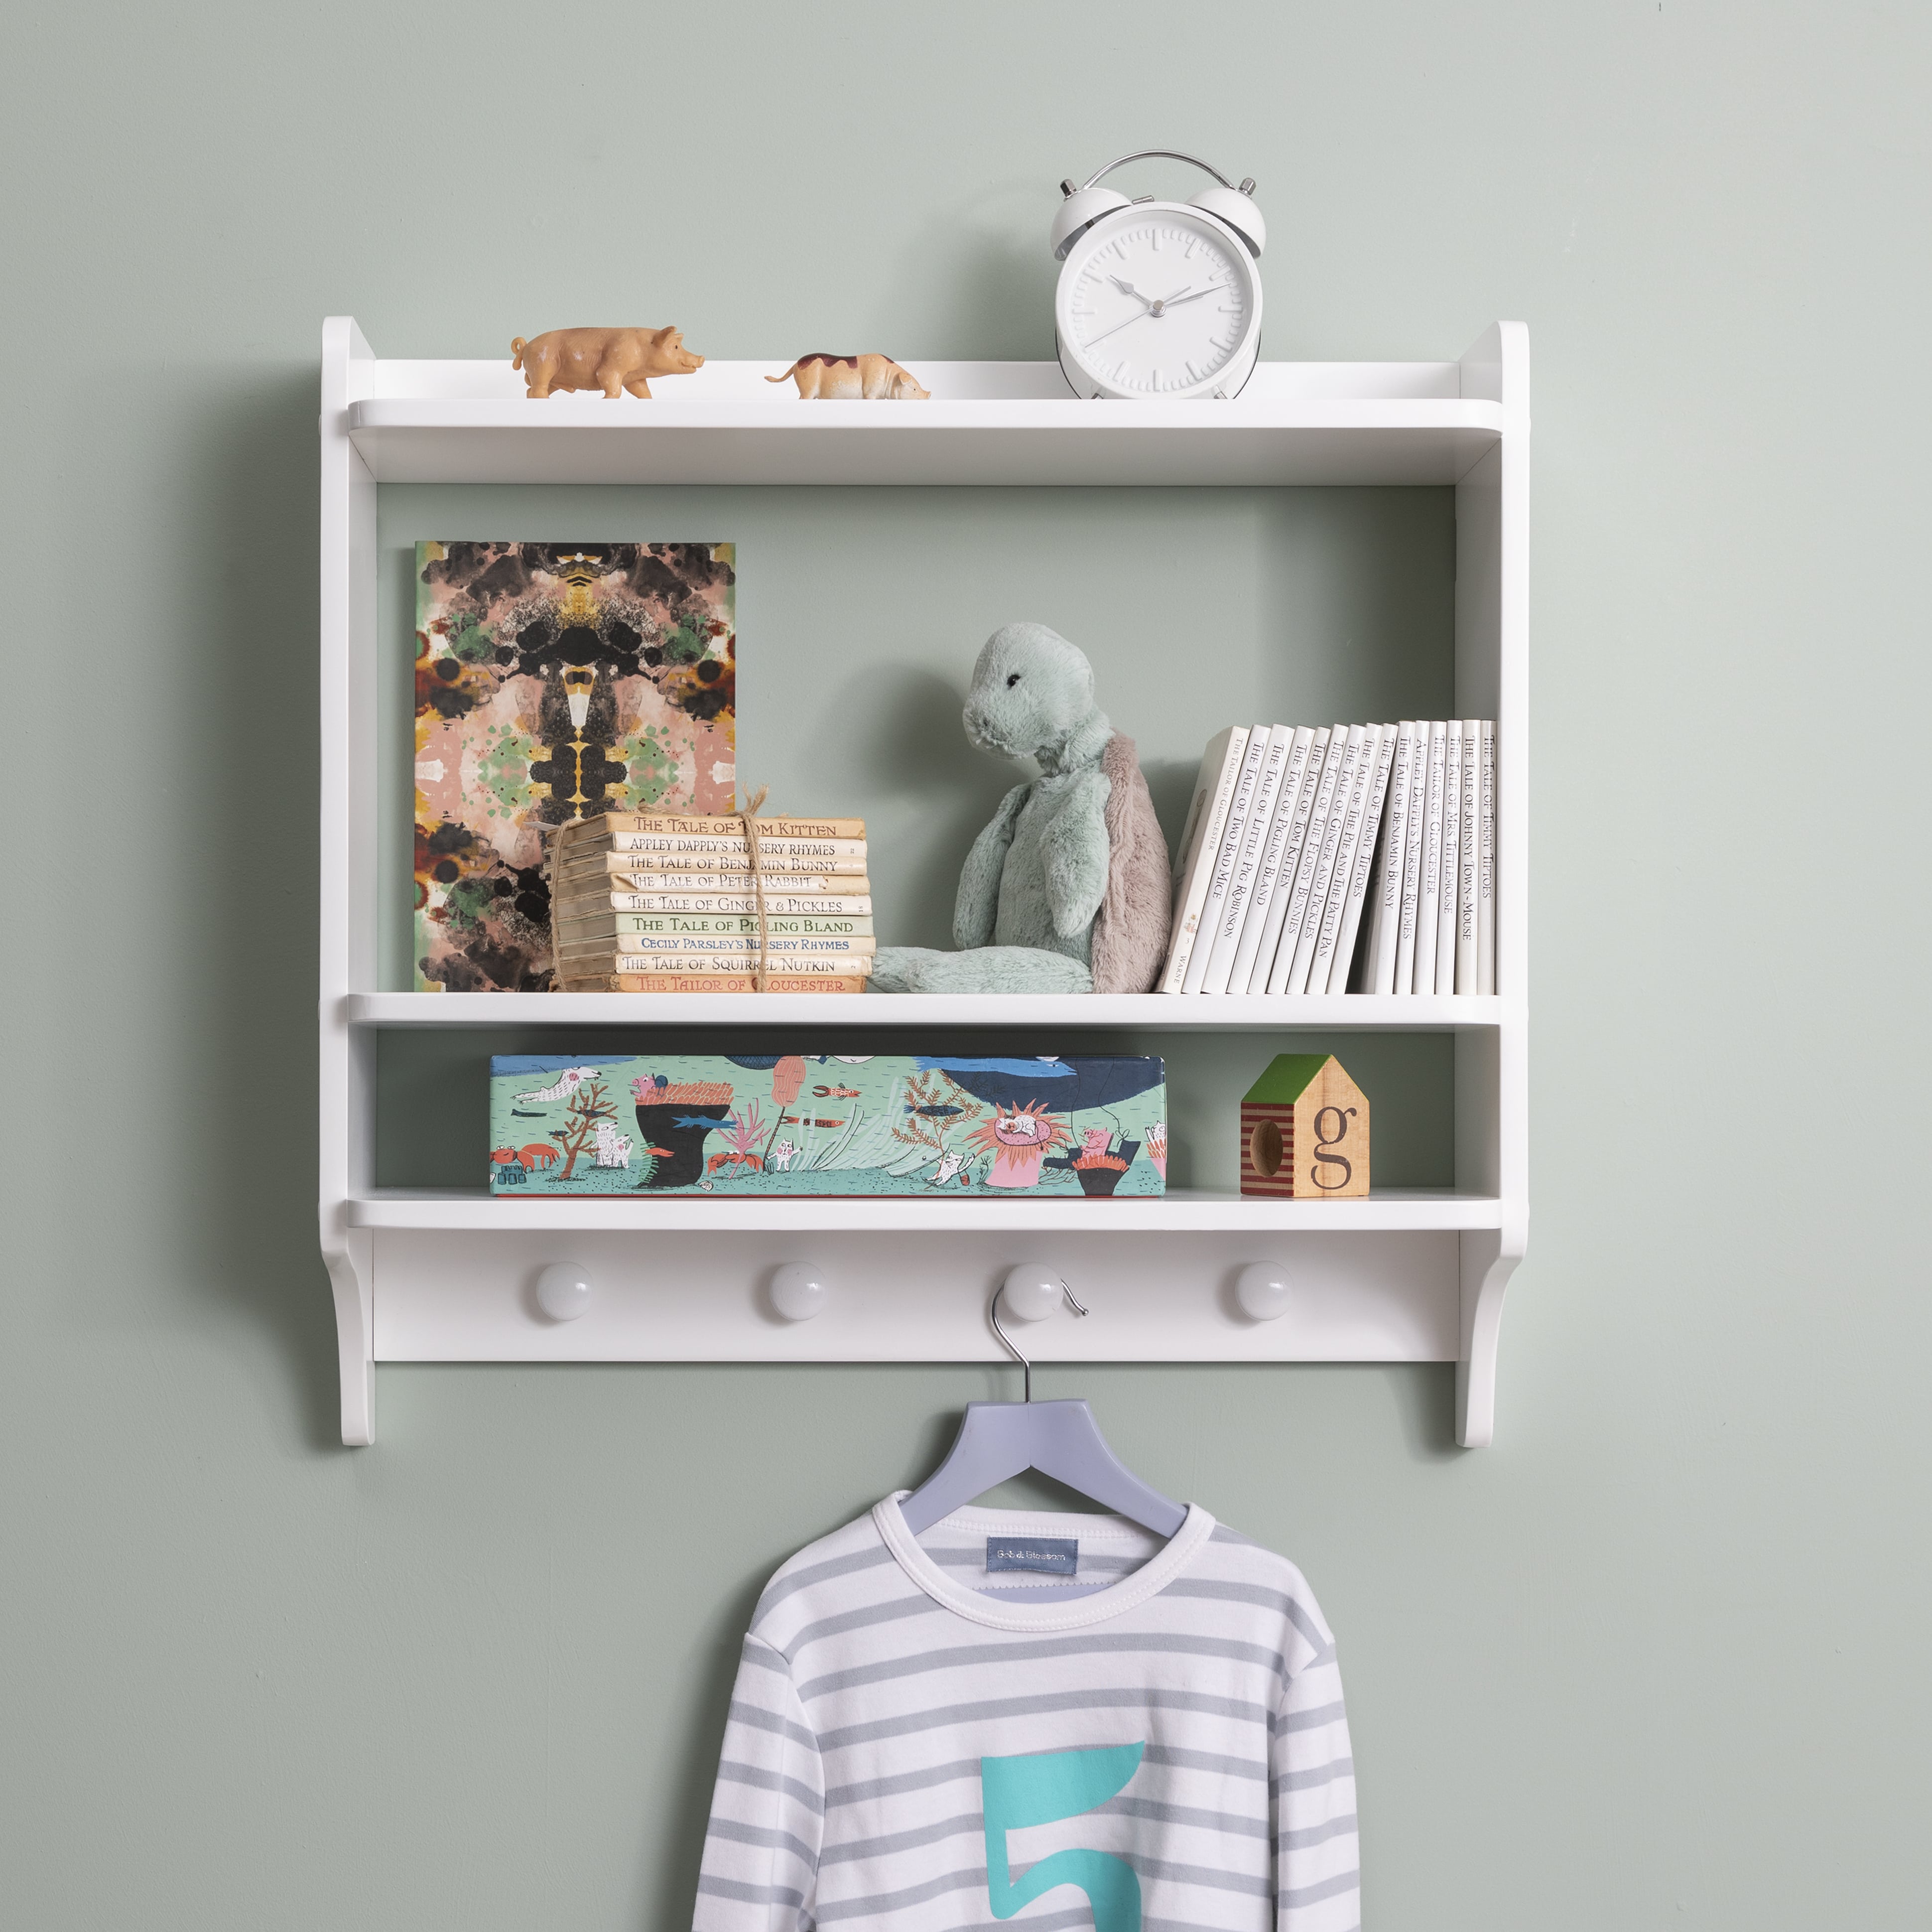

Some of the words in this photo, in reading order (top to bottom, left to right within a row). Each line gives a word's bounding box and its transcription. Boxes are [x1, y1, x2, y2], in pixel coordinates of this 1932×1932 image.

[1233, 738, 1243, 755] THE
[1250, 742, 1264, 764] THE
[1270, 744, 1284, 765] THE
[1293, 744, 1307, 766] THE
[1311, 743, 1326, 765] THE
[1330, 741, 1344, 762] THE
[1345, 743, 1360, 765] THE
[1362, 738, 1375, 759] THE
[1381, 738, 1395, 760] THE
[1399, 736, 1411, 758] THE
[1434, 735, 1445, 756] THE
[1450, 735, 1460, 757] THE
[1465, 735, 1476, 758] THE
[1484, 735, 1495, 757] THE
[1225, 757, 1238, 785] TAILOR
[1415, 739, 1426, 783] APPLEY
[1241, 767, 1257, 795] TALE
[1261, 769, 1278, 797] TALE
[1285, 770, 1301, 797] TALE
[1303, 769, 1320, 797] TALE
[1322, 766, 1337, 794] TALE
[1338, 769, 1353, 797] TALE
[1355, 763, 1369, 789] TALE
[1374, 764, 1389, 792] TALE
[1396, 761, 1408, 790] TALE
[1432, 759, 1443, 800] TAILOR
[1448, 761, 1459, 789] TALE
[1465, 762, 1475, 790] TALE
[1484, 762, 1494, 791] TALE
[1222, 787, 1232, 798] OF
[1352, 792, 1361, 806] OF
[1371, 796, 1381, 811] OF
[1395, 793, 1403, 808] OF
[1448, 794, 1456, 808] OF
[1465, 794, 1473, 809] OF
[1484, 795, 1492, 809] OF
[1236, 798, 1246, 816] OF
[1257, 800, 1267, 815] OF
[1281, 800, 1290, 816] OF
[1299, 800, 1309, 816] OF
[1318, 797, 1328, 812] OF
[1334, 800, 1343, 816] OF
[1431, 803, 1439, 817] OF
[634, 817, 662, 831] THE
[667, 819, 708, 832] TALE
[714, 823, 736, 833] OF
[778, 823, 836, 835] KITTEN
[1208, 800, 1227, 850] GLOUCESTER
[1229, 817, 1244, 839] TWO
[1311, 817, 1326, 838] THE
[1347, 809, 1360, 829] THE
[1245, 819, 1264, 858] LITTLE
[1267, 819, 1288, 863] PIGLING
[1292, 820, 1306, 842] TOM
[1322, 818, 1341, 860] GINGER
[1342, 832, 1355, 849] PIE
[1363, 814, 1379, 850] TIMMY
[1389, 811, 1404, 866] BENJAMIN
[1464, 811, 1474, 858] JOHNNY
[1483, 813, 1494, 849] TIMMY
[630, 838, 673, 850] APPLEY
[677, 840, 728, 851] DAPPLY'S
[732, 841, 785, 853] NUSERY
[789, 844, 835, 855] RHYMES
[1221, 843, 1236, 867] BAD
[1427, 822, 1440, 894] GLOUCESTER
[628, 854, 654, 868] THE
[658, 855, 691, 868] TALE
[697, 859, 714, 869] OF
[791, 858, 838, 871] BUNNY
[1239, 861, 1253, 881] PIG
[1280, 846, 1299, 889] KITTEN
[1301, 842, 1319, 883] FLOPSY
[1336, 852, 1347, 876] AND
[1407, 840, 1419, 890] NURSERY
[630, 874, 654, 886] THE
[660, 874, 692, 886] TALE
[698, 876, 714, 886] OF
[719, 873, 757, 886] PETER
[765, 874, 812, 887] RABBIT
[1213, 869, 1229, 899] MICE
[1257, 866, 1276, 905] BLAND
[1316, 864, 1328, 889] AND
[1353, 853, 1371, 897] TIPTOES
[1444, 840, 1456, 914] TITTLEMOUSE
[1482, 853, 1494, 898] TIPTOES
[1331, 877, 1345, 899] THE
[1385, 870, 1398, 909] BUNNY
[628, 895, 654, 908] THE
[659, 896, 690, 909] TALE
[695, 900, 712, 910] OF
[718, 897, 773, 911] GINGR
[776, 902, 784, 911] &
[787, 898, 843, 912] PICKLES
[1224, 885, 1247, 939] ROBINSON
[1288, 886, 1308, 935] BUNNIES
[633, 918, 663, 930] THE
[669, 918, 709, 931] TALE
[715, 921, 733, 931] OF
[803, 920, 853, 932] BLAND
[1304, 893, 1324, 939] PICKLES
[1324, 901, 1340, 935] PATTY
[1403, 894, 1416, 939] RHYMES
[642, 938, 680, 949] CECILY
[683, 938, 743, 950] PARSLEY'S
[746, 939, 798, 950] NUSERY
[801, 939, 850, 950] RHYMES
[1319, 937, 1332, 958] PAN
[622, 956, 647, 969] THE
[652, 956, 683, 969] TALE
[689, 959, 706, 969] OF
[780, 958, 835, 971] NUTKIN
[1174, 955, 1186, 983] WARNE
[637, 976, 666, 990] THE
[670, 976, 723, 990] TAILOR
[728, 979, 746, 991] OF
[1311, 1106, 1357, 1190] g
[981, 1740, 1145, 1932] 5
